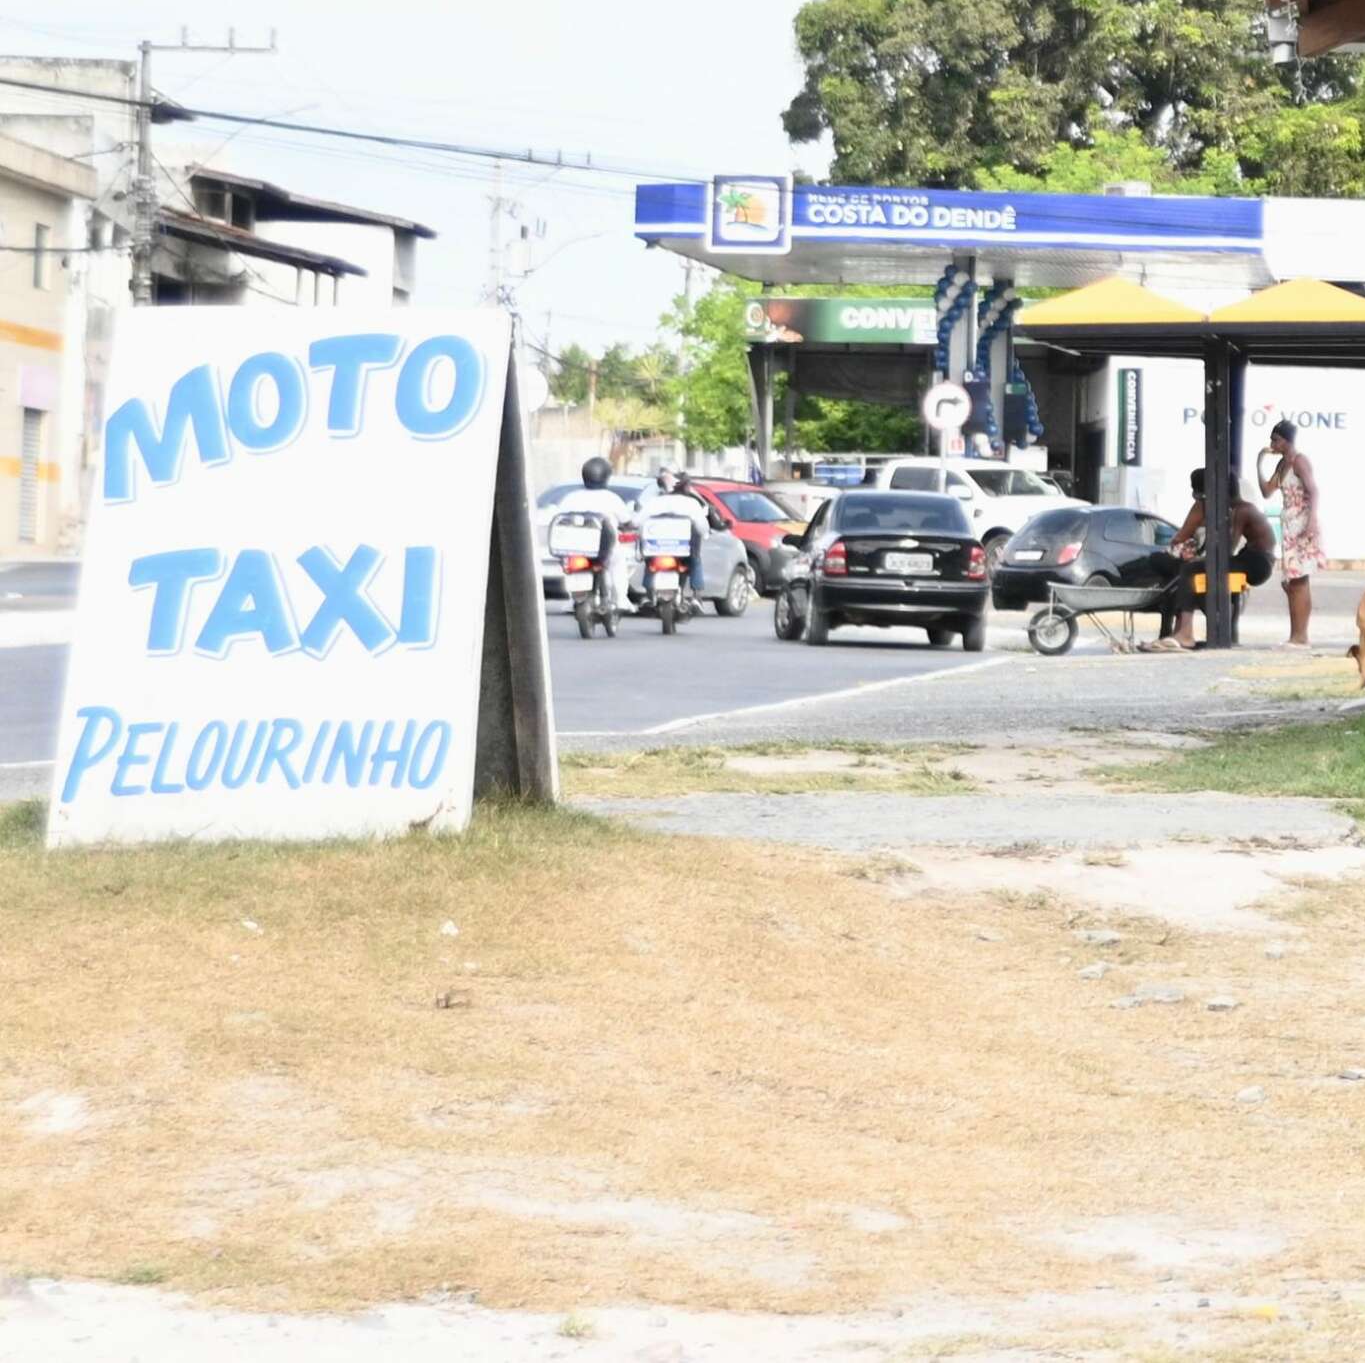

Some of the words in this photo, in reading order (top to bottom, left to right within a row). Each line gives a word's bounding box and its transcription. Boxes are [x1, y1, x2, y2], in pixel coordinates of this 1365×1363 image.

[807, 204, 887, 224] COSTA
[892, 205, 929, 227] DO
[932, 204, 1017, 229] DENDÊ
[103, 333, 487, 504] MOTO
[128, 544, 441, 660] TAXI
[61, 705, 453, 804] PELOURINHO
